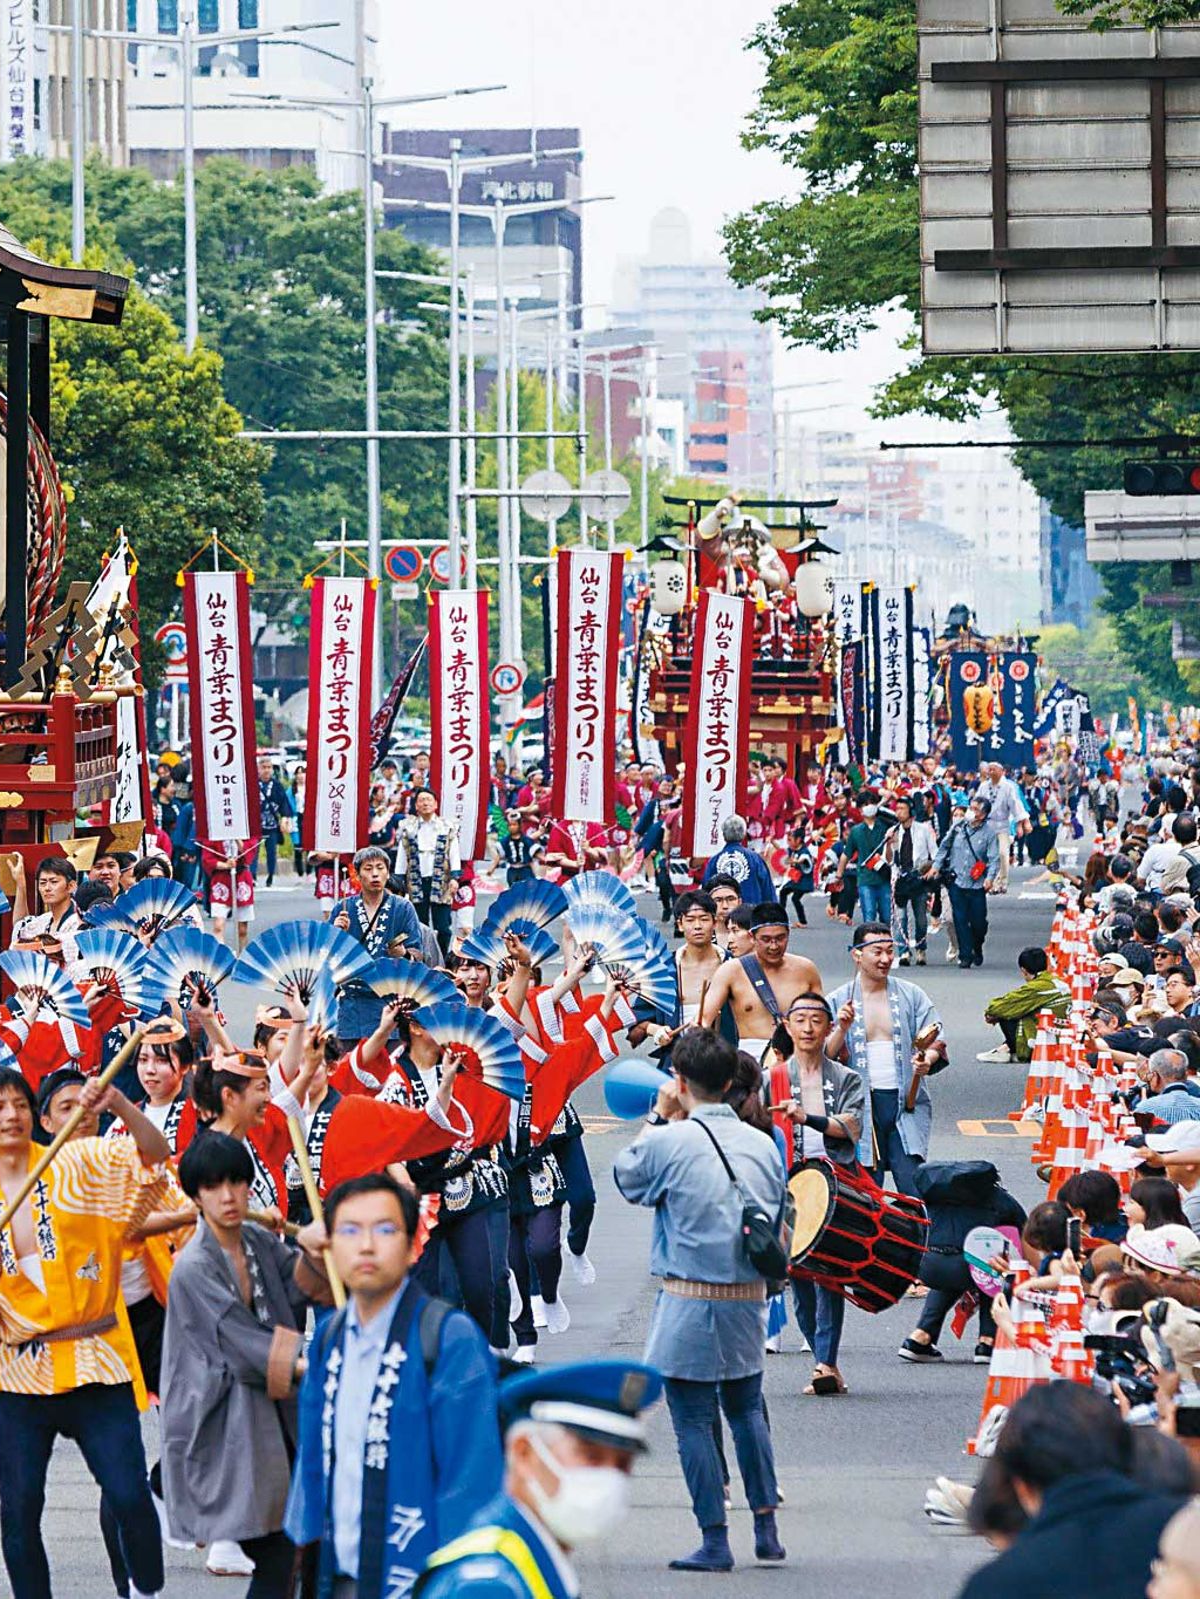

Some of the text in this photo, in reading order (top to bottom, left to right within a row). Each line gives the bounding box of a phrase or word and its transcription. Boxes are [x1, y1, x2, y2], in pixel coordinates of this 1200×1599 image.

[205, 592, 238, 767] 仙台青葉まつり
[325, 595, 356, 779] 仙台青葉まつり
[446, 606, 475, 789] 仙台青葉まつり
[574, 567, 602, 748] 仙台青葉まつり
[704, 612, 735, 791] 仙台青葉まつり
[883, 598, 903, 719] 仙台青葉まつり
[34, 1179, 56, 1260] 七十七銀行
